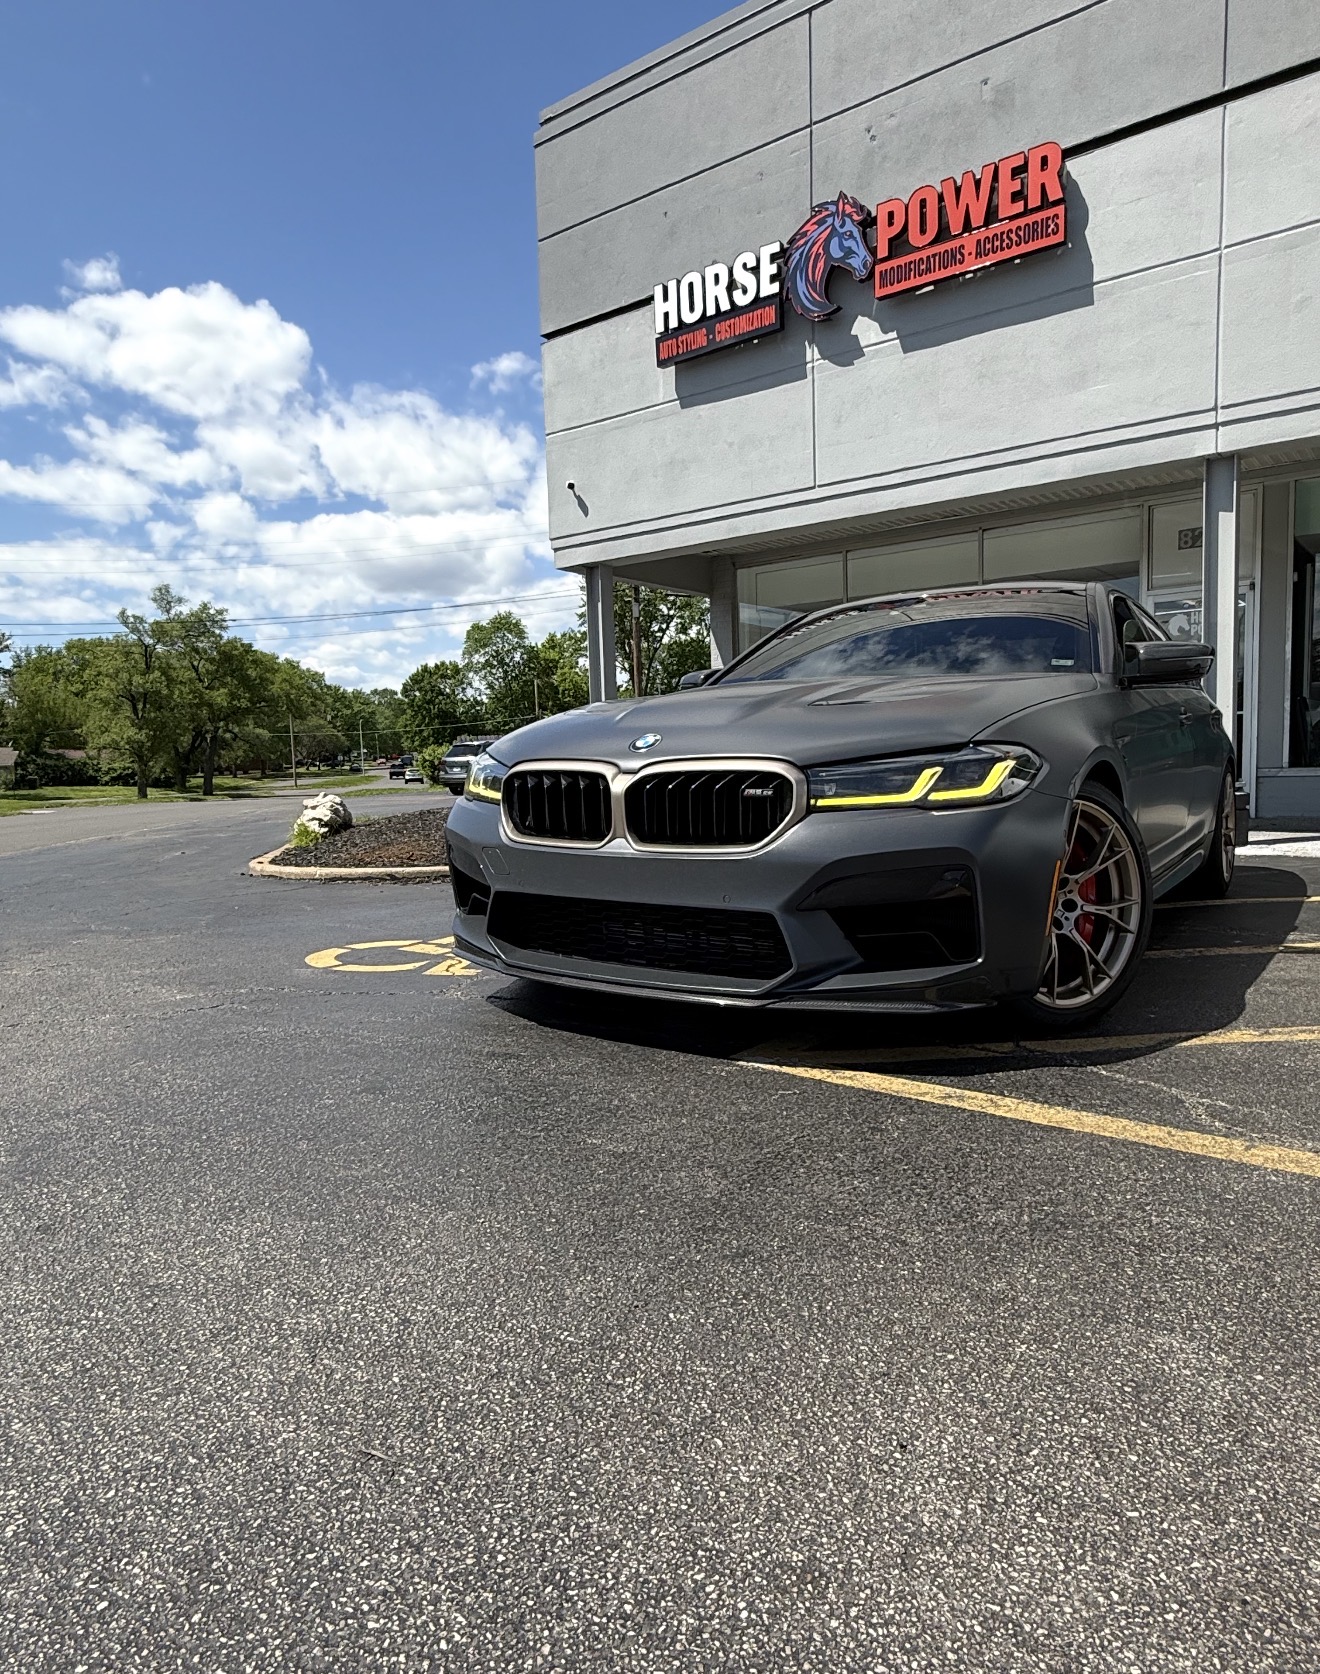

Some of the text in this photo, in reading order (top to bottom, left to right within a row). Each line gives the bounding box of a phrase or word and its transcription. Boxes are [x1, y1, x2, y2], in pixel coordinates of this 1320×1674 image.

[653, 141, 1064, 334] HORSE POWER
[879, 244, 966, 290] MODIFICATIONS
[975, 213, 1060, 260] ACCESSORIES
[659, 338, 678, 360] AUTO
[678, 327, 708, 354] STYLING
[715, 304, 776, 342] CUSTOMIZATION
